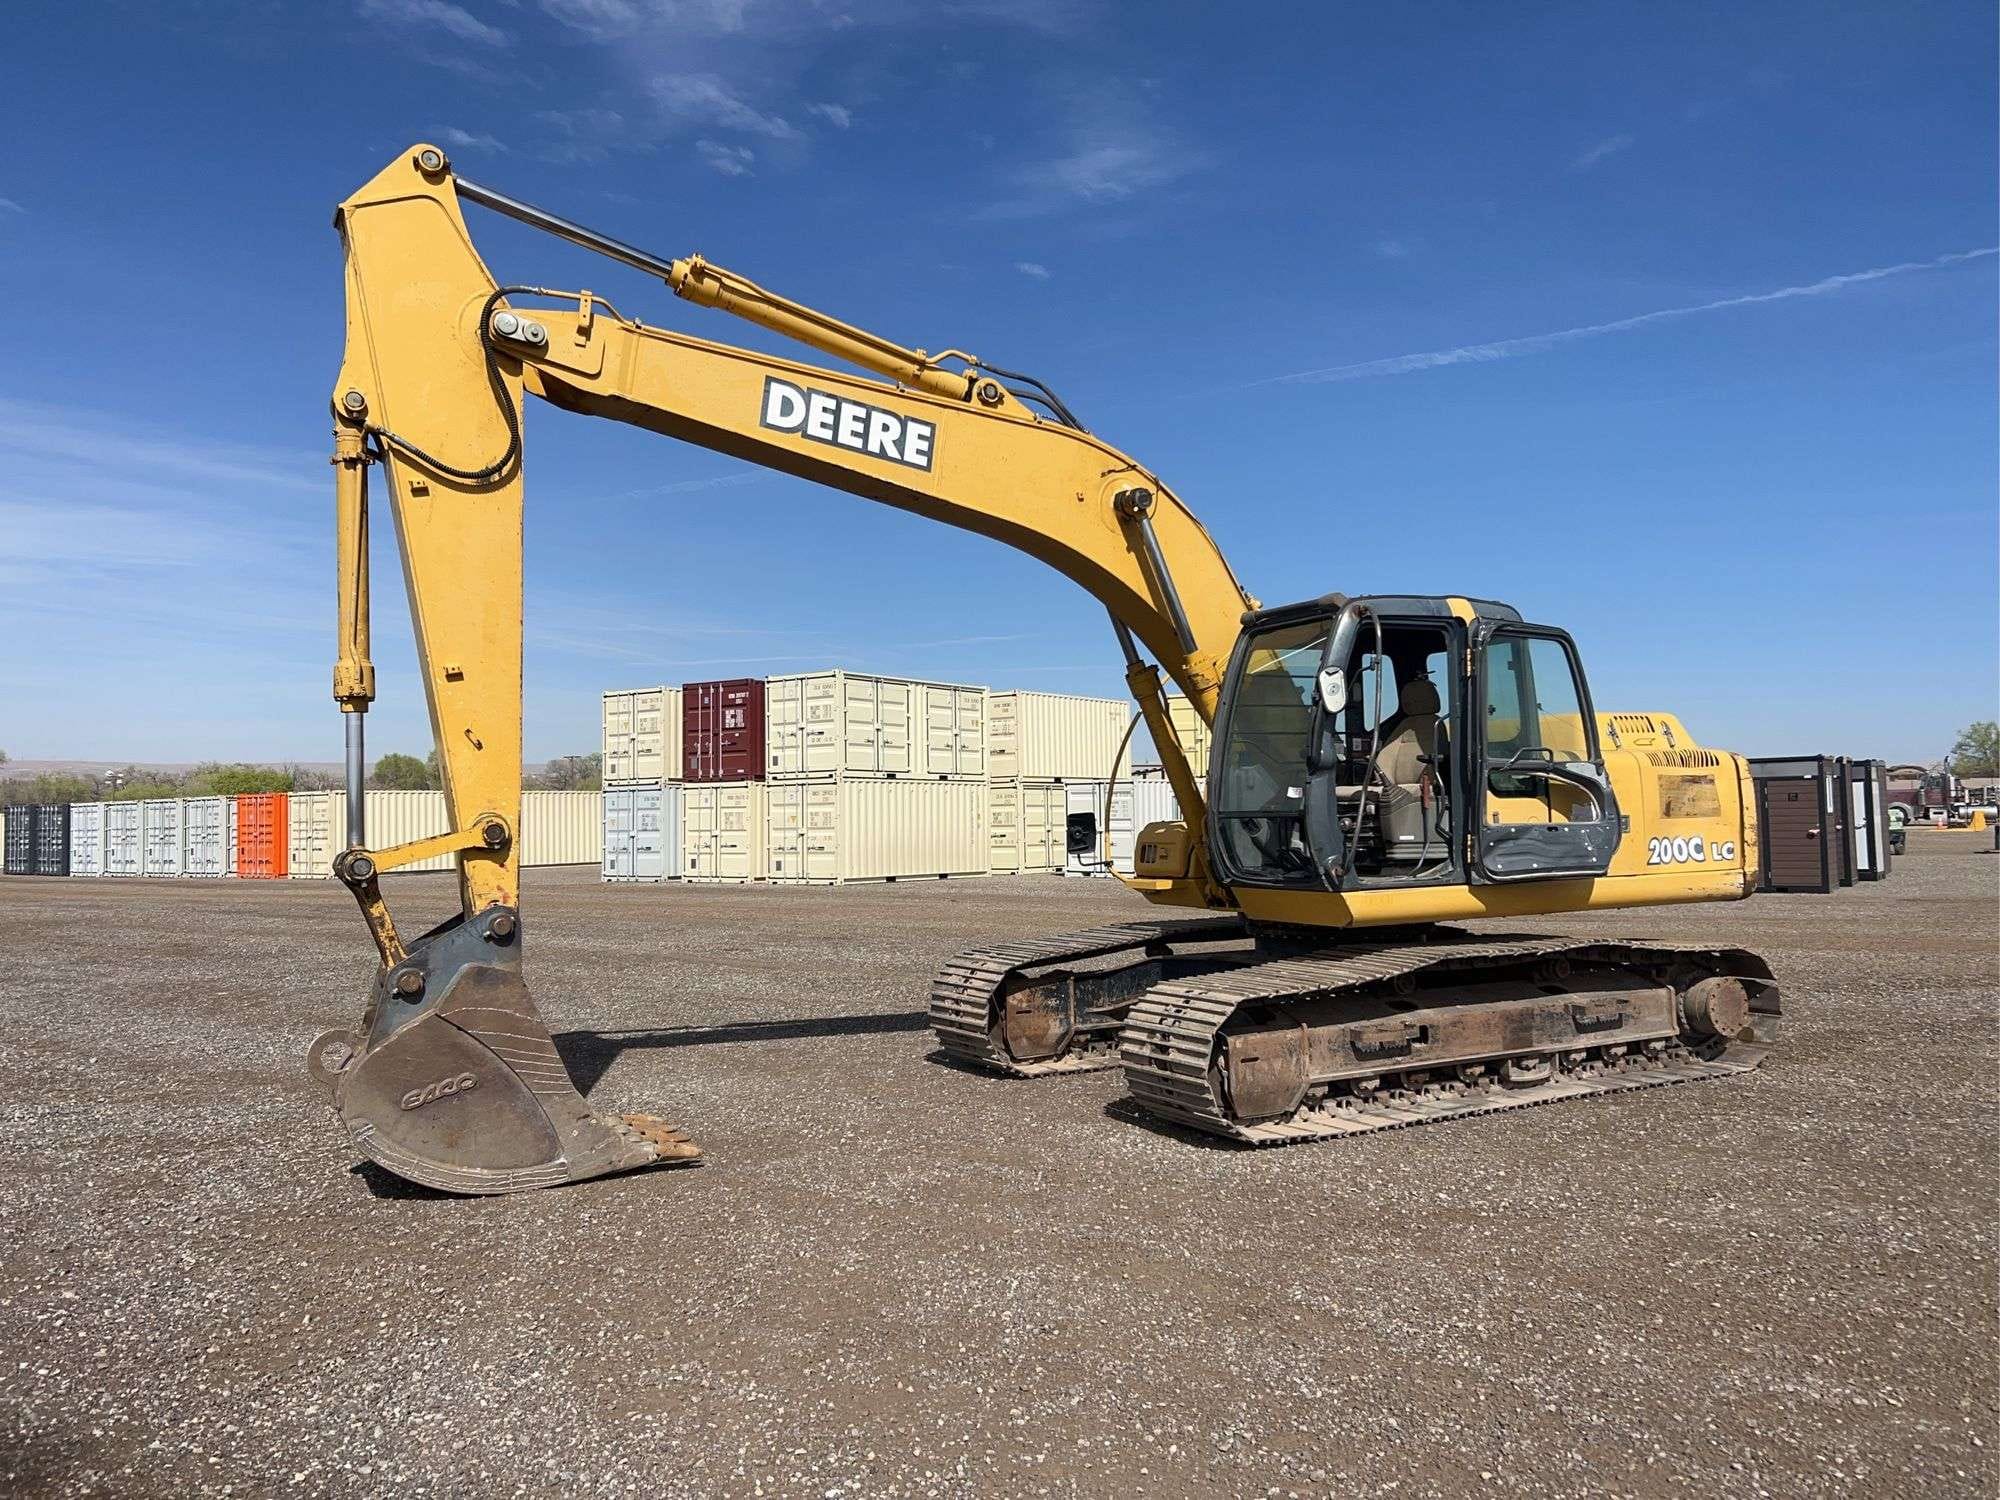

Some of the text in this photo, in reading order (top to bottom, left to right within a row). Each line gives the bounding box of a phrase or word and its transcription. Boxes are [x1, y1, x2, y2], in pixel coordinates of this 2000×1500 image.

[763, 379, 934, 469] DEERE
[1647, 836, 1735, 865] 200C LC
